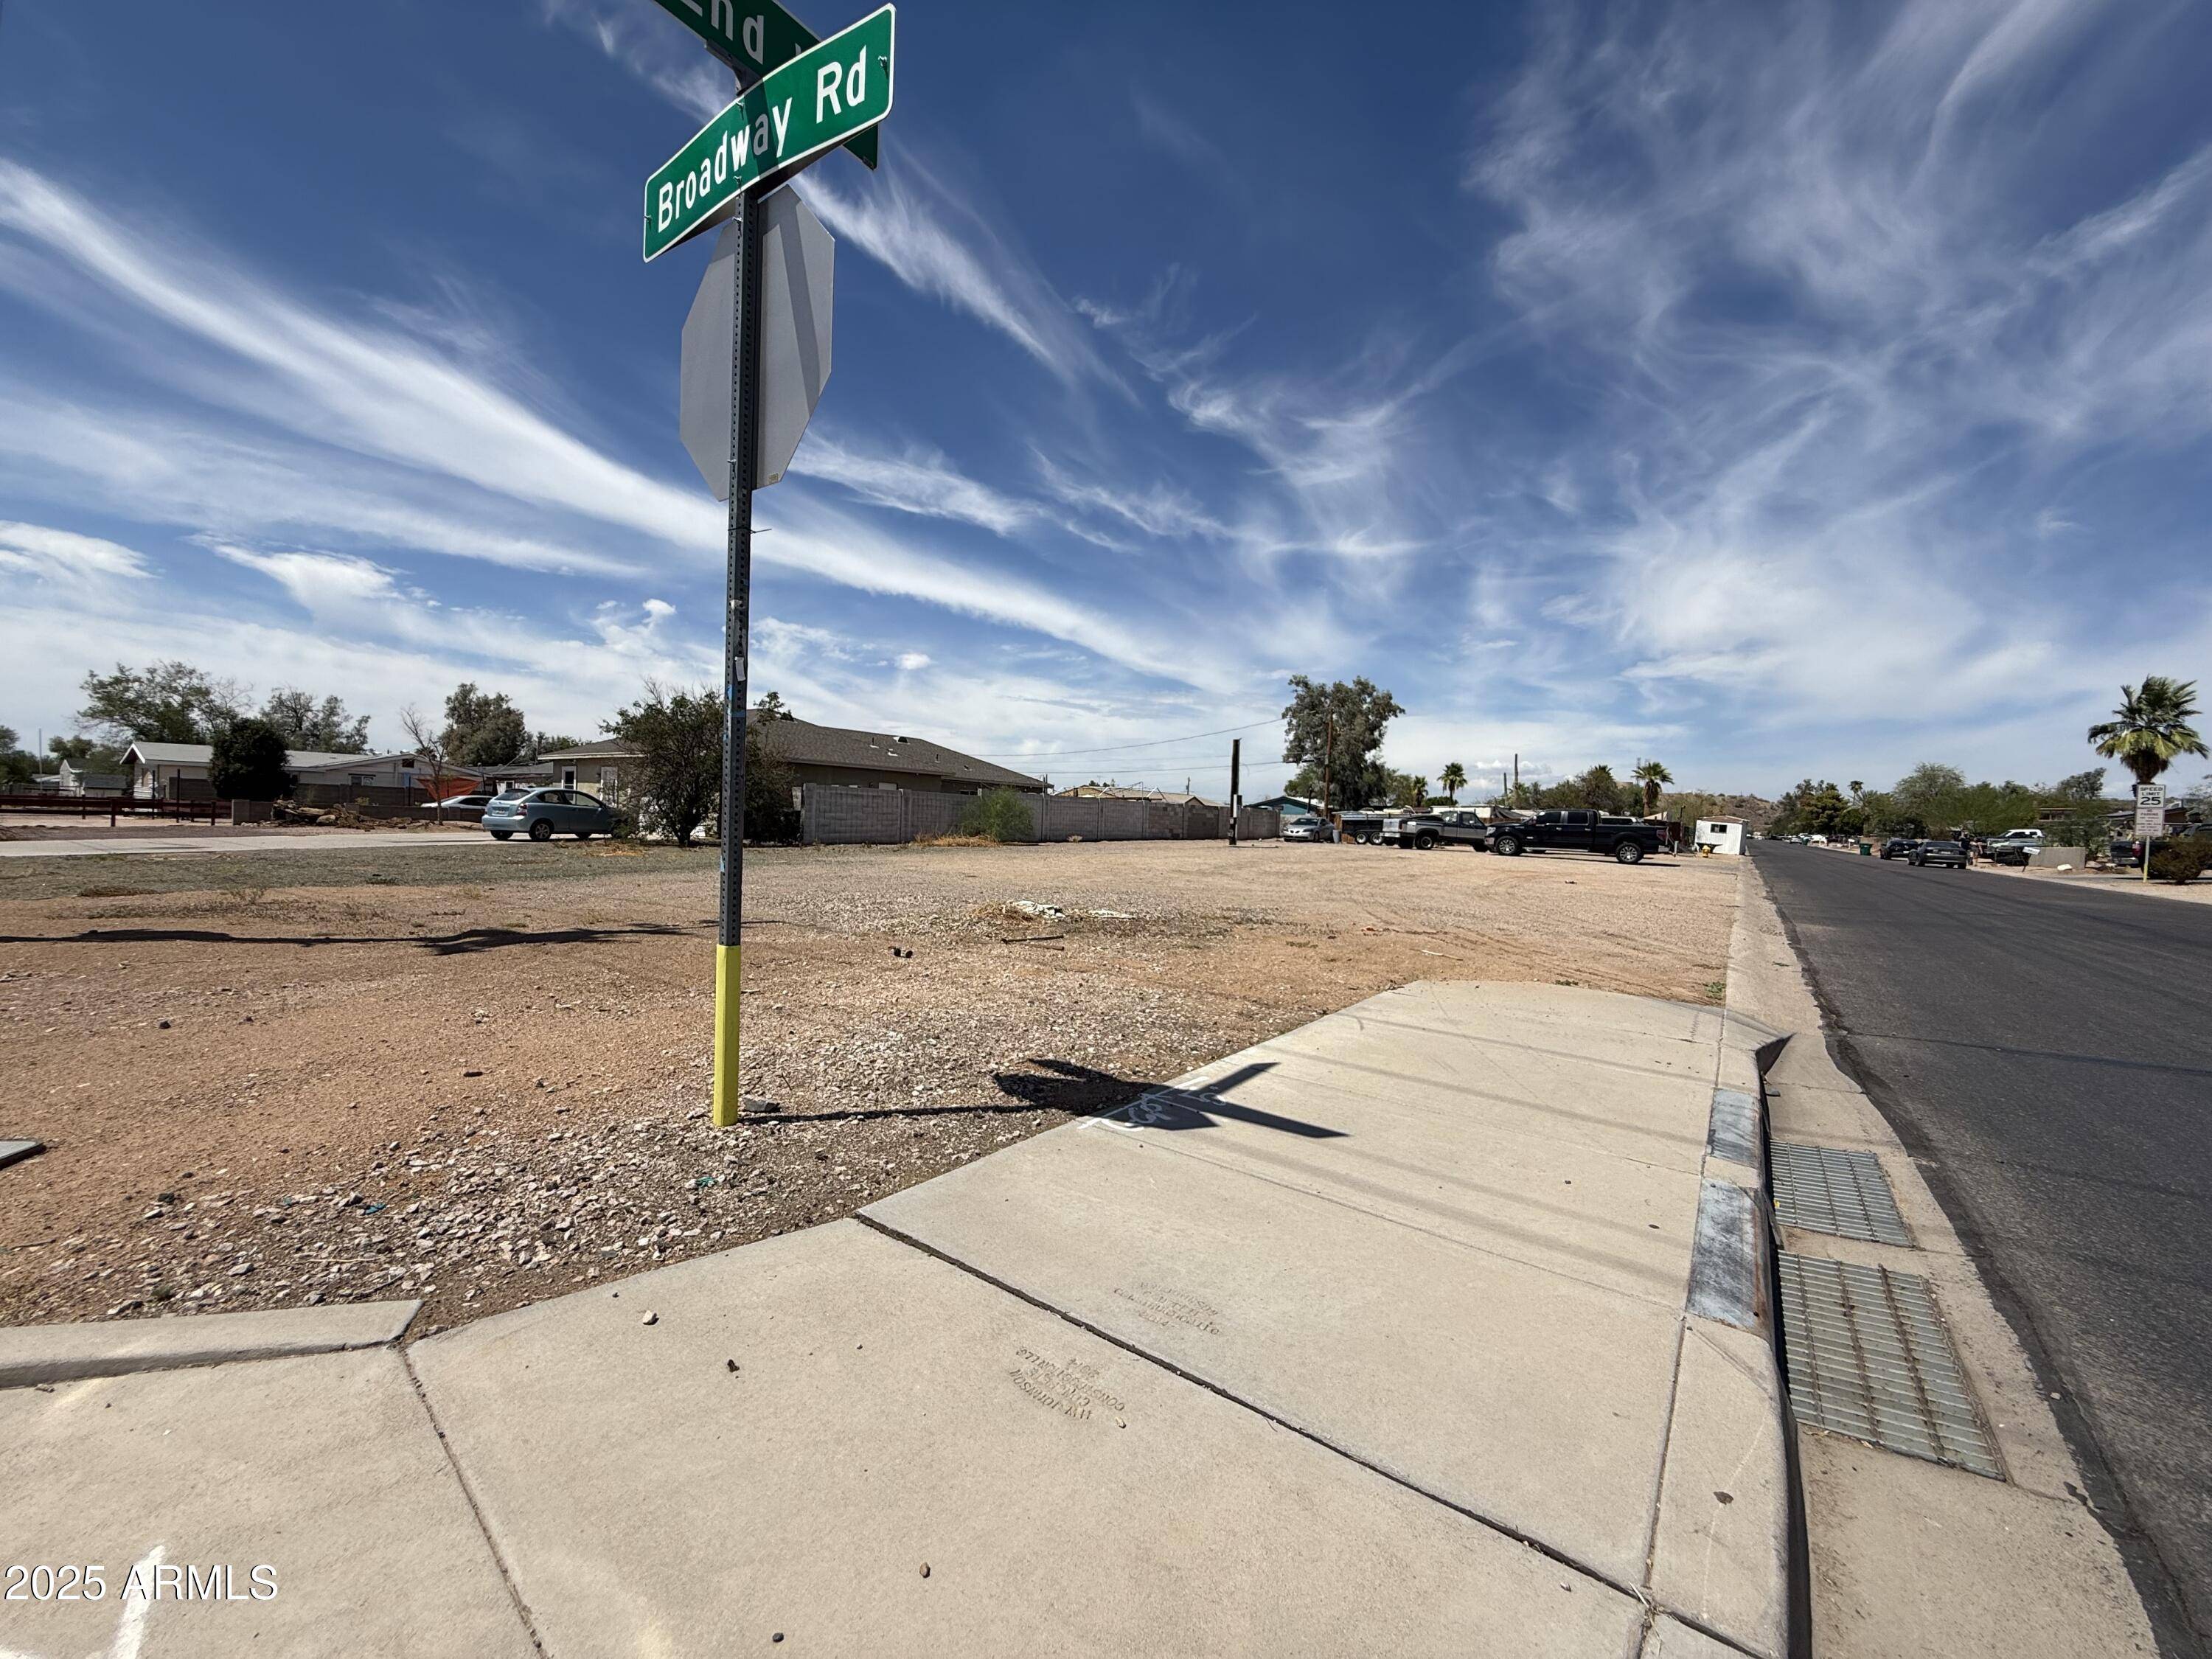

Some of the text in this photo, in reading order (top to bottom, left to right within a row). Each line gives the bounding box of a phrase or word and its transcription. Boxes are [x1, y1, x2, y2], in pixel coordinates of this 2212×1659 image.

[667, 0, 764, 65] nd
[658, 44, 867, 233] Broadway Rd
[2140, 796, 2161, 805] 25
